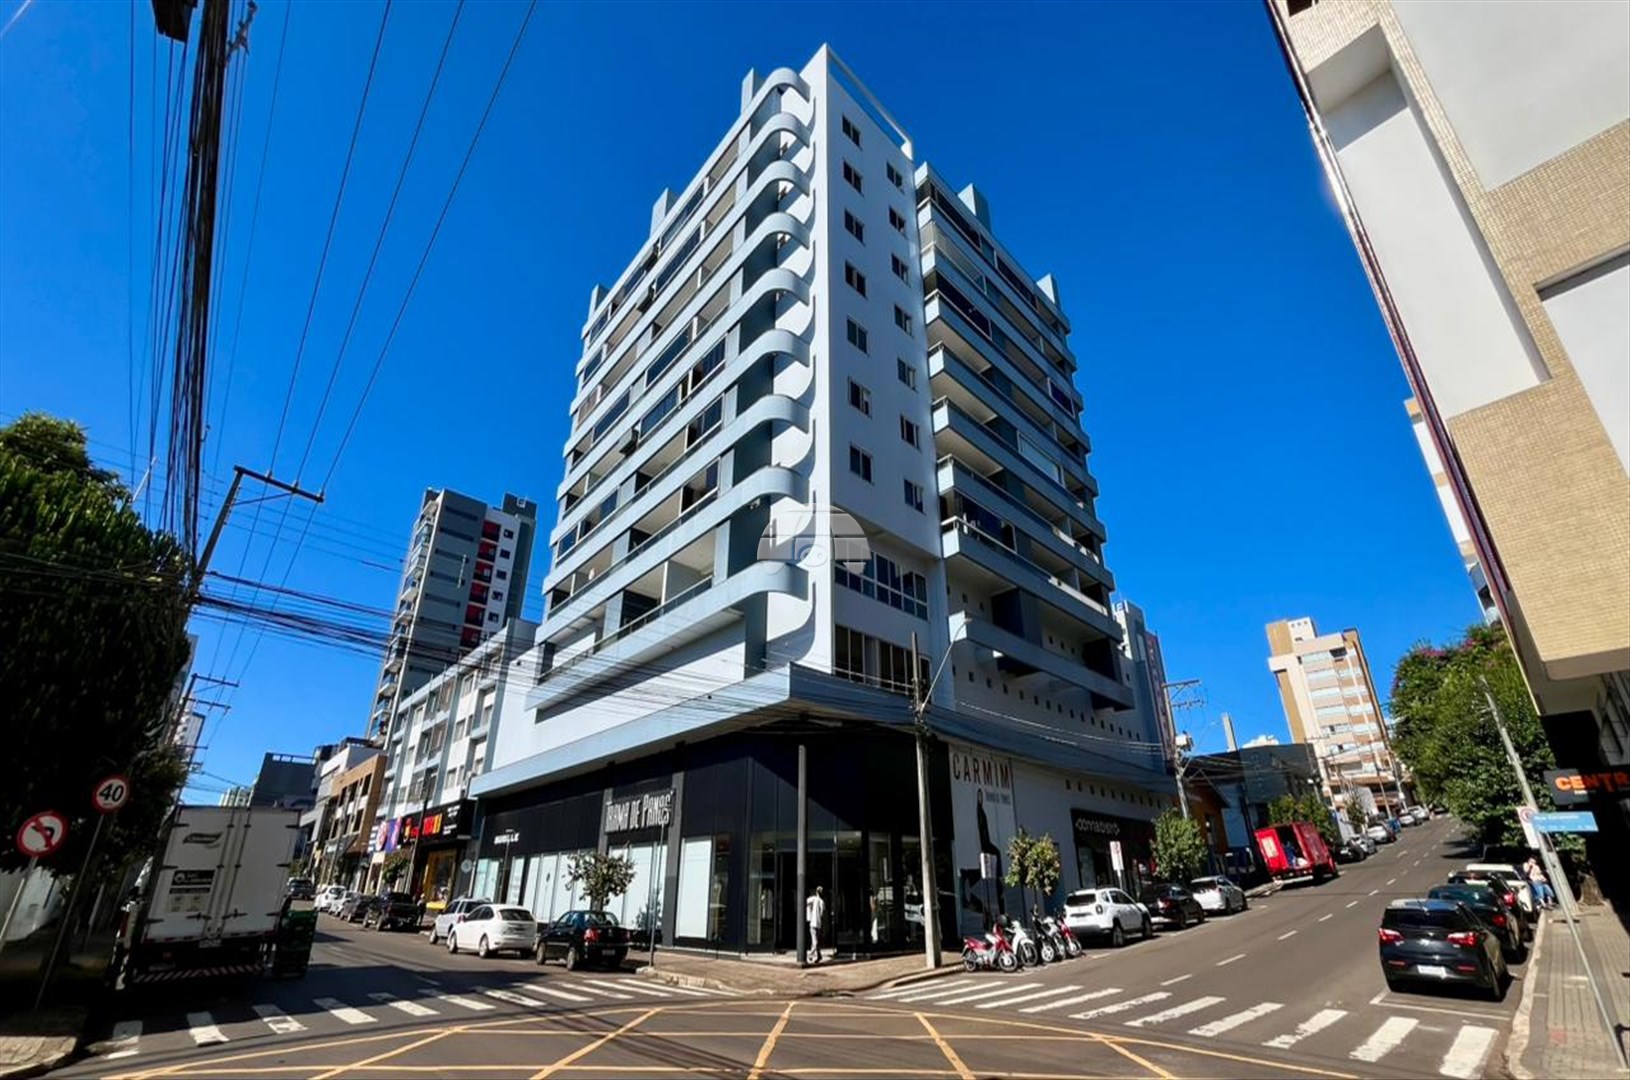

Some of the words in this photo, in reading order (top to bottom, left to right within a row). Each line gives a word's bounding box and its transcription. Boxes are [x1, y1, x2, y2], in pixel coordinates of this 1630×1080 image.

[953, 753, 1010, 789] CARMIM
[99, 783, 124, 803] 40
[629, 800, 640, 829] DE
